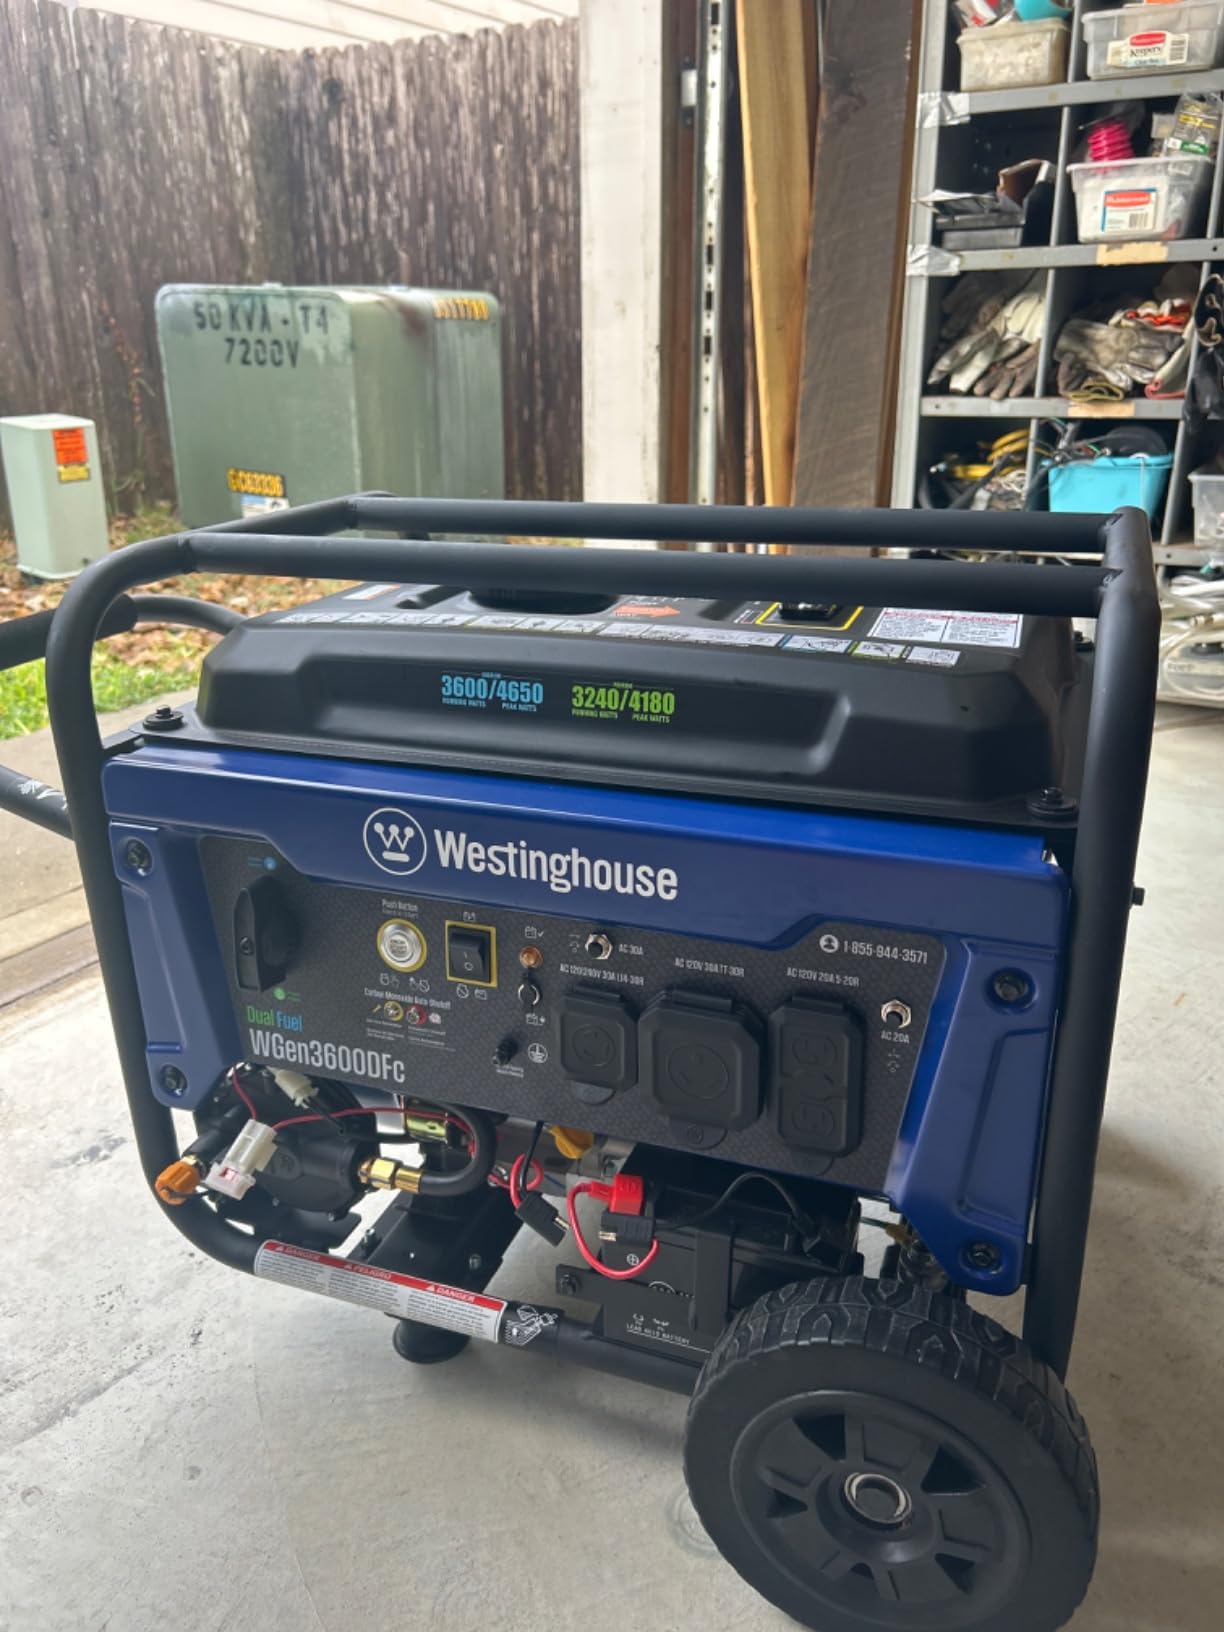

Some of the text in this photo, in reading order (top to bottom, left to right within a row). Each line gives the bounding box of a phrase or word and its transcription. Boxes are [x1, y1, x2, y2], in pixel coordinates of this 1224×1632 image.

[194, 301, 222, 331] 50
[229, 303, 272, 333] KVA
[299, 304, 328, 335] T4
[224, 337, 299, 369] 7200V
[441, 674, 544, 704] 3600/4650
[571, 685, 675, 715] 3240/4180
[434, 829, 679, 900] Westinghouse
[618, 943, 630, 953] AC
[843, 940, 928, 965] 1-855-944-3571
[560, 963, 570, 973] AC
[674, 957, 686, 968] AC
[787, 966, 798, 978] AC
[247, 1006, 303, 1031] Dual Fuel
[881, 1029, 910, 1044] AC 20A
[249, 1027, 405, 1083] WGen3600DFc
[436, 1287, 476, 1303] DANGER
